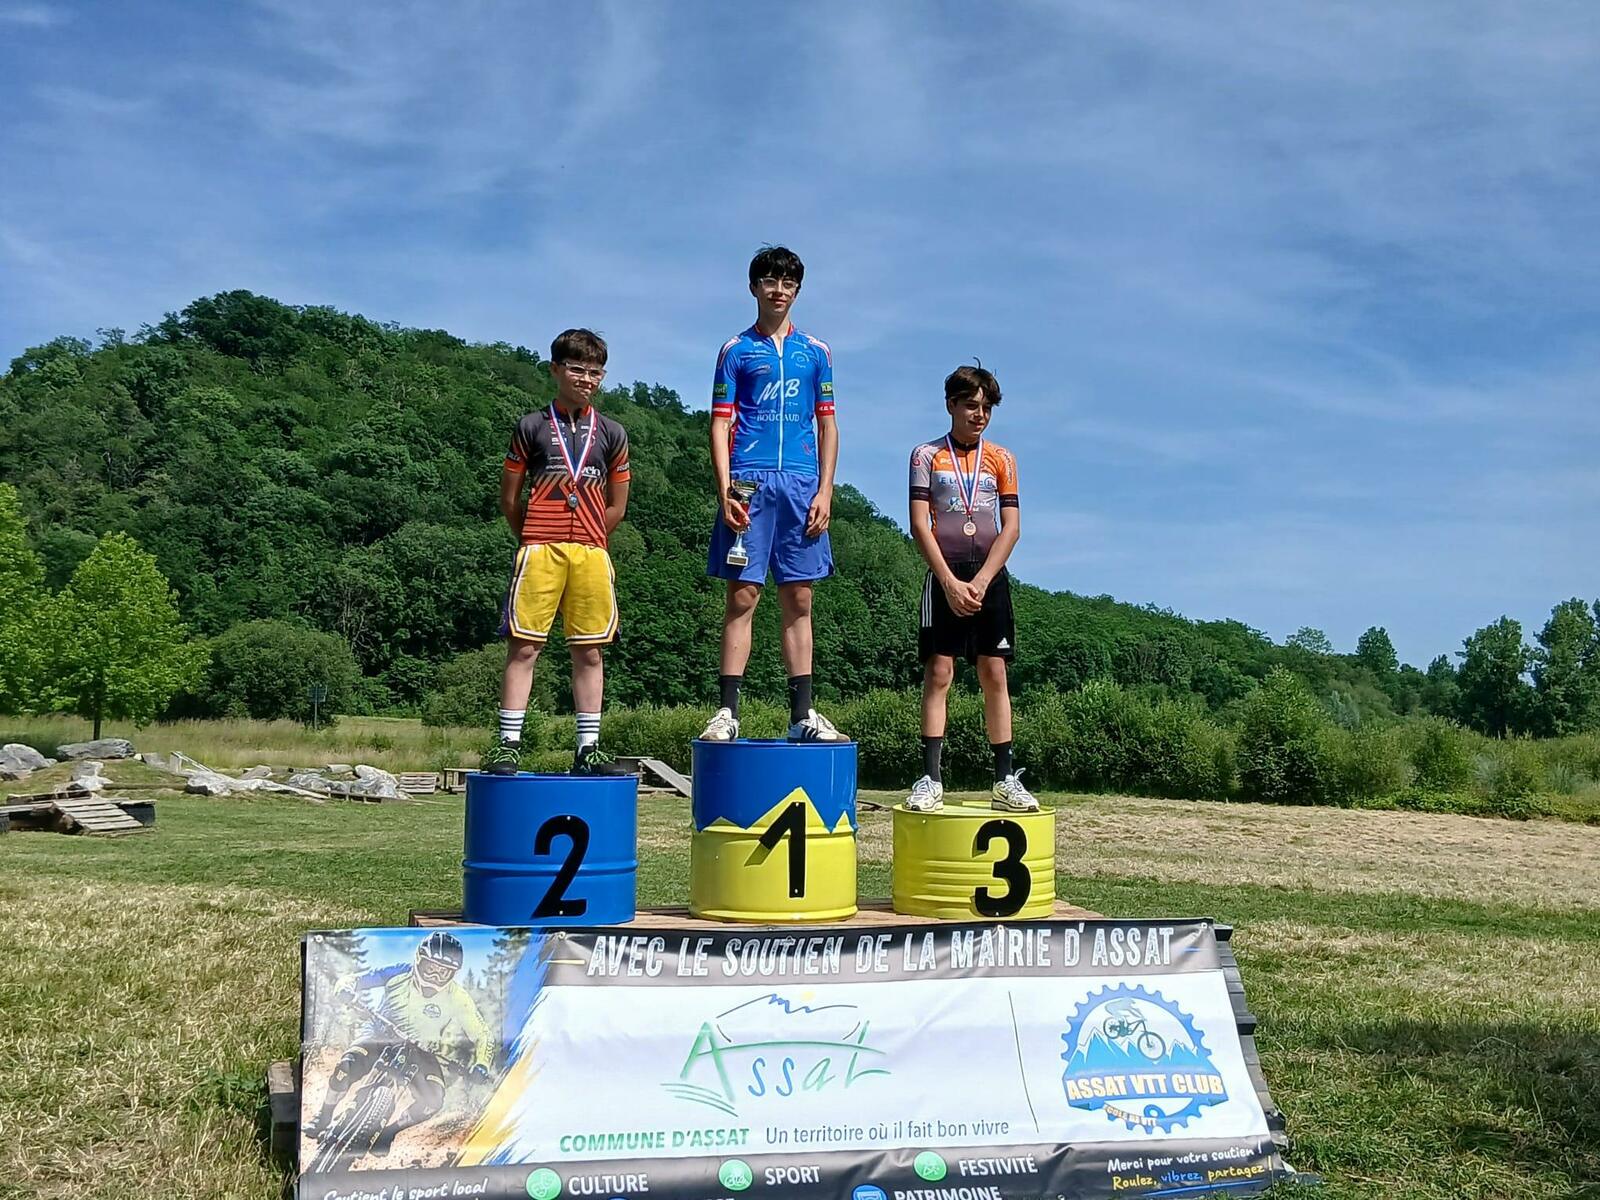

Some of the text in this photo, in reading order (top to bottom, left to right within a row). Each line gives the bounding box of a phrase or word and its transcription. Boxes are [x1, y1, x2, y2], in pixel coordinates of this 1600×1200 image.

[758, 802, 807, 898] 1
[531, 815, 590, 919] 2
[972, 820, 1032, 918] 3
[586, 934, 665, 977] AVEC
[677, 937, 714, 977] LE
[721, 937, 845, 977] SOUTIEN
[855, 934, 893, 974] DE
[903, 931, 937, 972] LA
[950, 927, 1052, 969] MAIRIE
[1066, 1073, 1225, 1100] ASSAT VTT CLUB
[559, 1128, 750, 1153] COMMUNE D'ASSAT
[766, 1119, 1009, 1144] Un territoire où il fait bon vivre
[765, 1165, 821, 1186] SPORT
[958, 1153, 1038, 1177] FESTIVITÉ
[1107, 1158, 1143, 1173] Merci
[1147, 1157, 1173, 1171] pour
[1177, 1154, 1208, 1165] votre
[392, 1185, 404, 1200] le
[408, 1183, 448, 1200] sport
[452, 1178, 488, 1196] local
[568, 1174, 649, 1195] CULTURE
[1112, 1175, 1157, 1191] Roulez,
[1160, 1170, 1203, 1183] vibrez,
